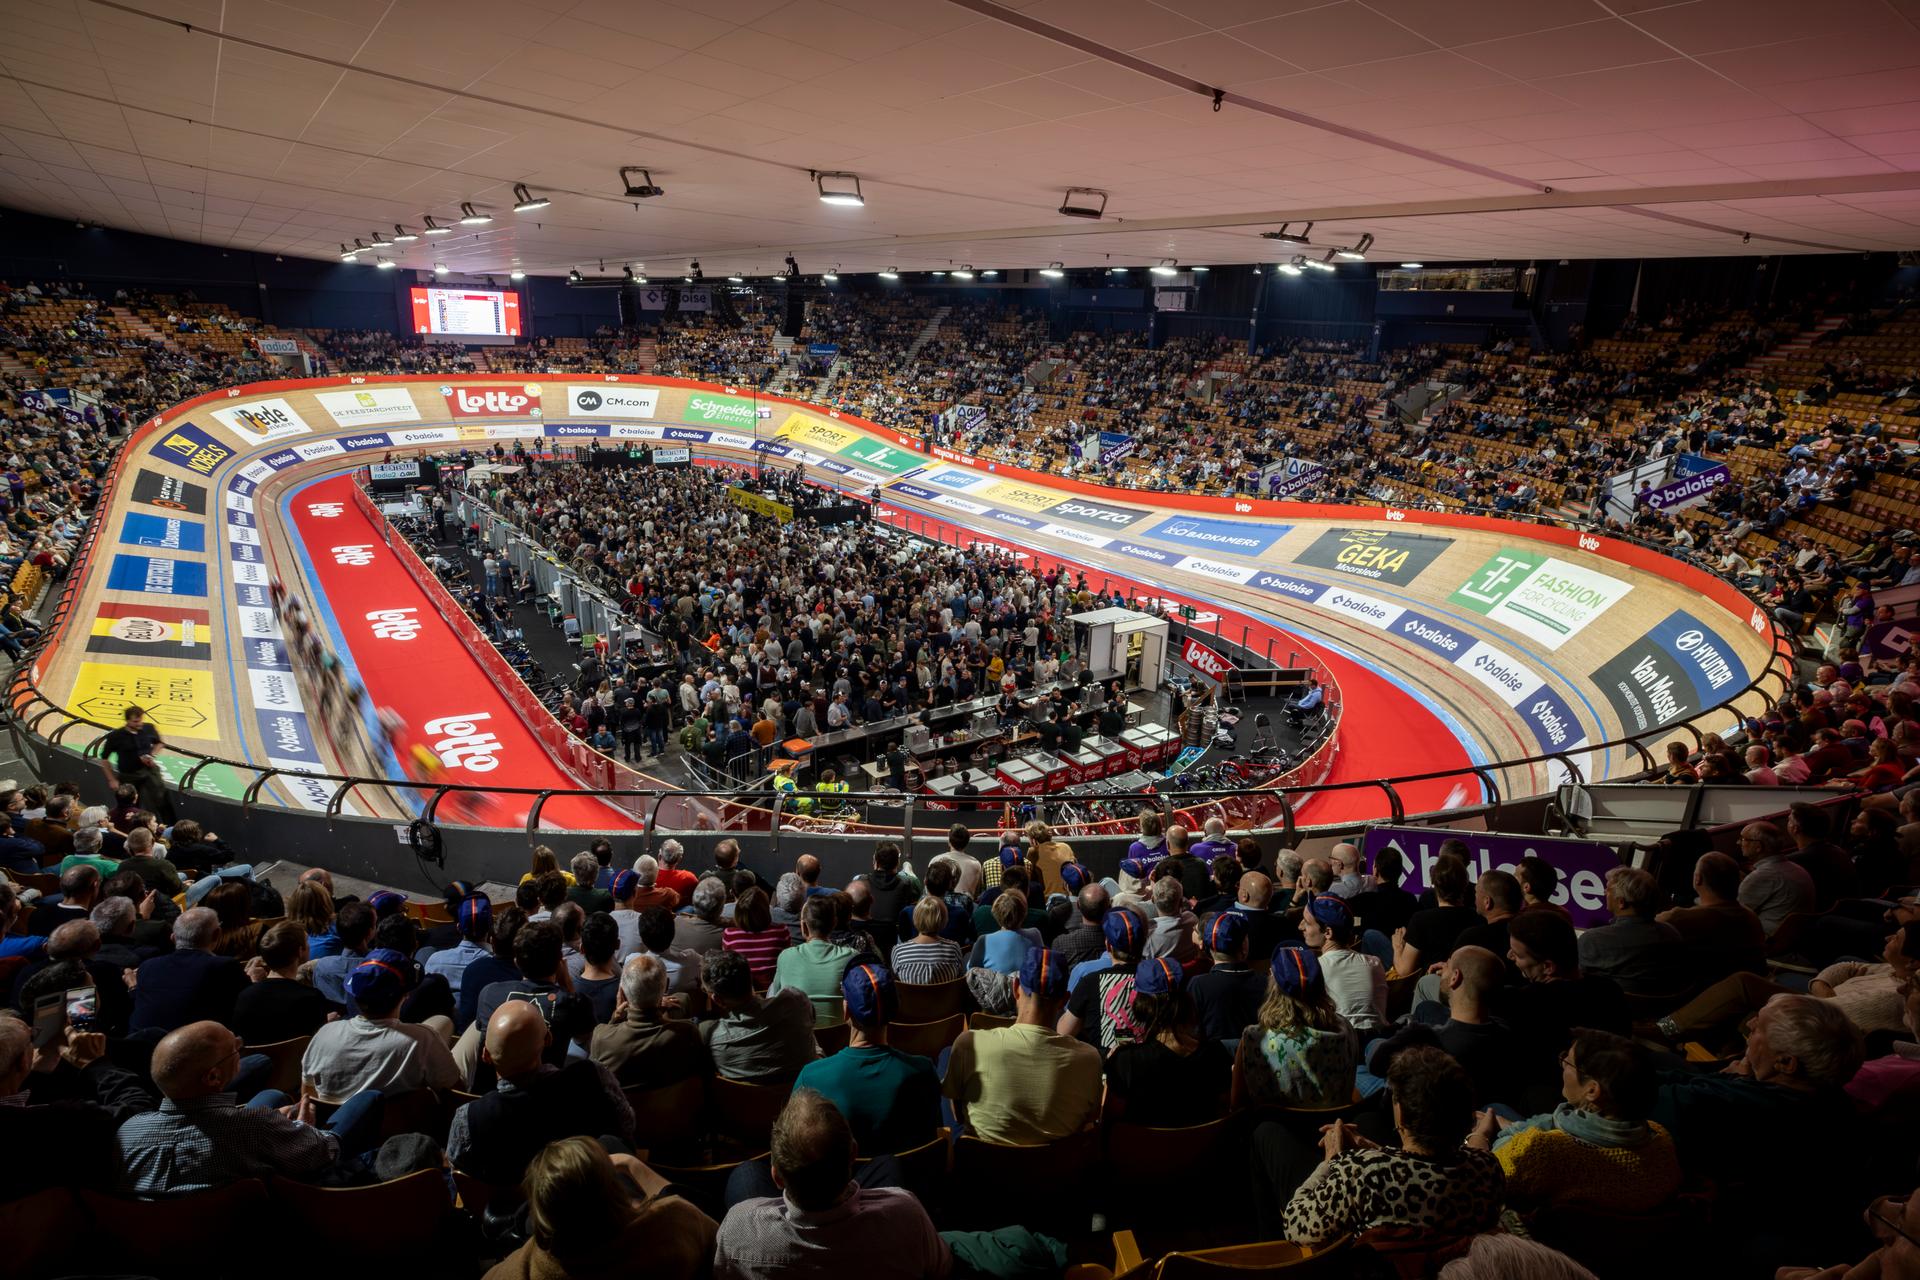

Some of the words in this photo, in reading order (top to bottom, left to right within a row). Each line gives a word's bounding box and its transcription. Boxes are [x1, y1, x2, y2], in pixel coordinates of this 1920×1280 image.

[661, 286, 707, 304] boise
[262, 342, 295, 351] radio2
[606, 397, 650, 408] CM.com
[690, 398, 757, 418] Schneider
[239, 405, 288, 428] Pede
[716, 411, 753, 425] Electric
[413, 432, 444, 440] baloise
[627, 428, 655, 436] baloise
[677, 431, 704, 440] baloise
[723, 437, 747, 446] baloise
[809, 425, 848, 441] SPORT
[310, 444, 335, 455] baloise
[355, 437, 384, 447] baloise
[186, 443, 229, 475] NOBELS
[1287, 470, 1322, 491] baloise
[1664, 472, 1726, 502] baloise
[1008, 488, 1056, 504] SPORT
[1063, 529, 1094, 543] baloise
[1187, 530, 1260, 548] BADKAMERS
[1130, 546, 1167, 561] baloise
[1336, 544, 1410, 573] GEKA
[1201, 561, 1241, 579] baloise
[1334, 563, 1382, 579] Moorslede
[1272, 578, 1314, 597] baloise
[1532, 573, 1608, 609] FASHION
[1343, 595, 1387, 620] baloise
[1519, 588, 1543, 604] FOR
[1541, 597, 1587, 622] CYCLING
[1415, 623, 1459, 652] baloise
[259, 641, 277, 662] baloise
[1484, 659, 1524, 693] baloise
[1690, 643, 1734, 691] HYUNDAI
[266, 675, 286, 699] baloise
[1630, 655, 1659, 687] Van
[1645, 675, 1688, 725] Mossel
[276, 716, 300, 746] baloise
[1536, 706, 1568, 747] baloise
